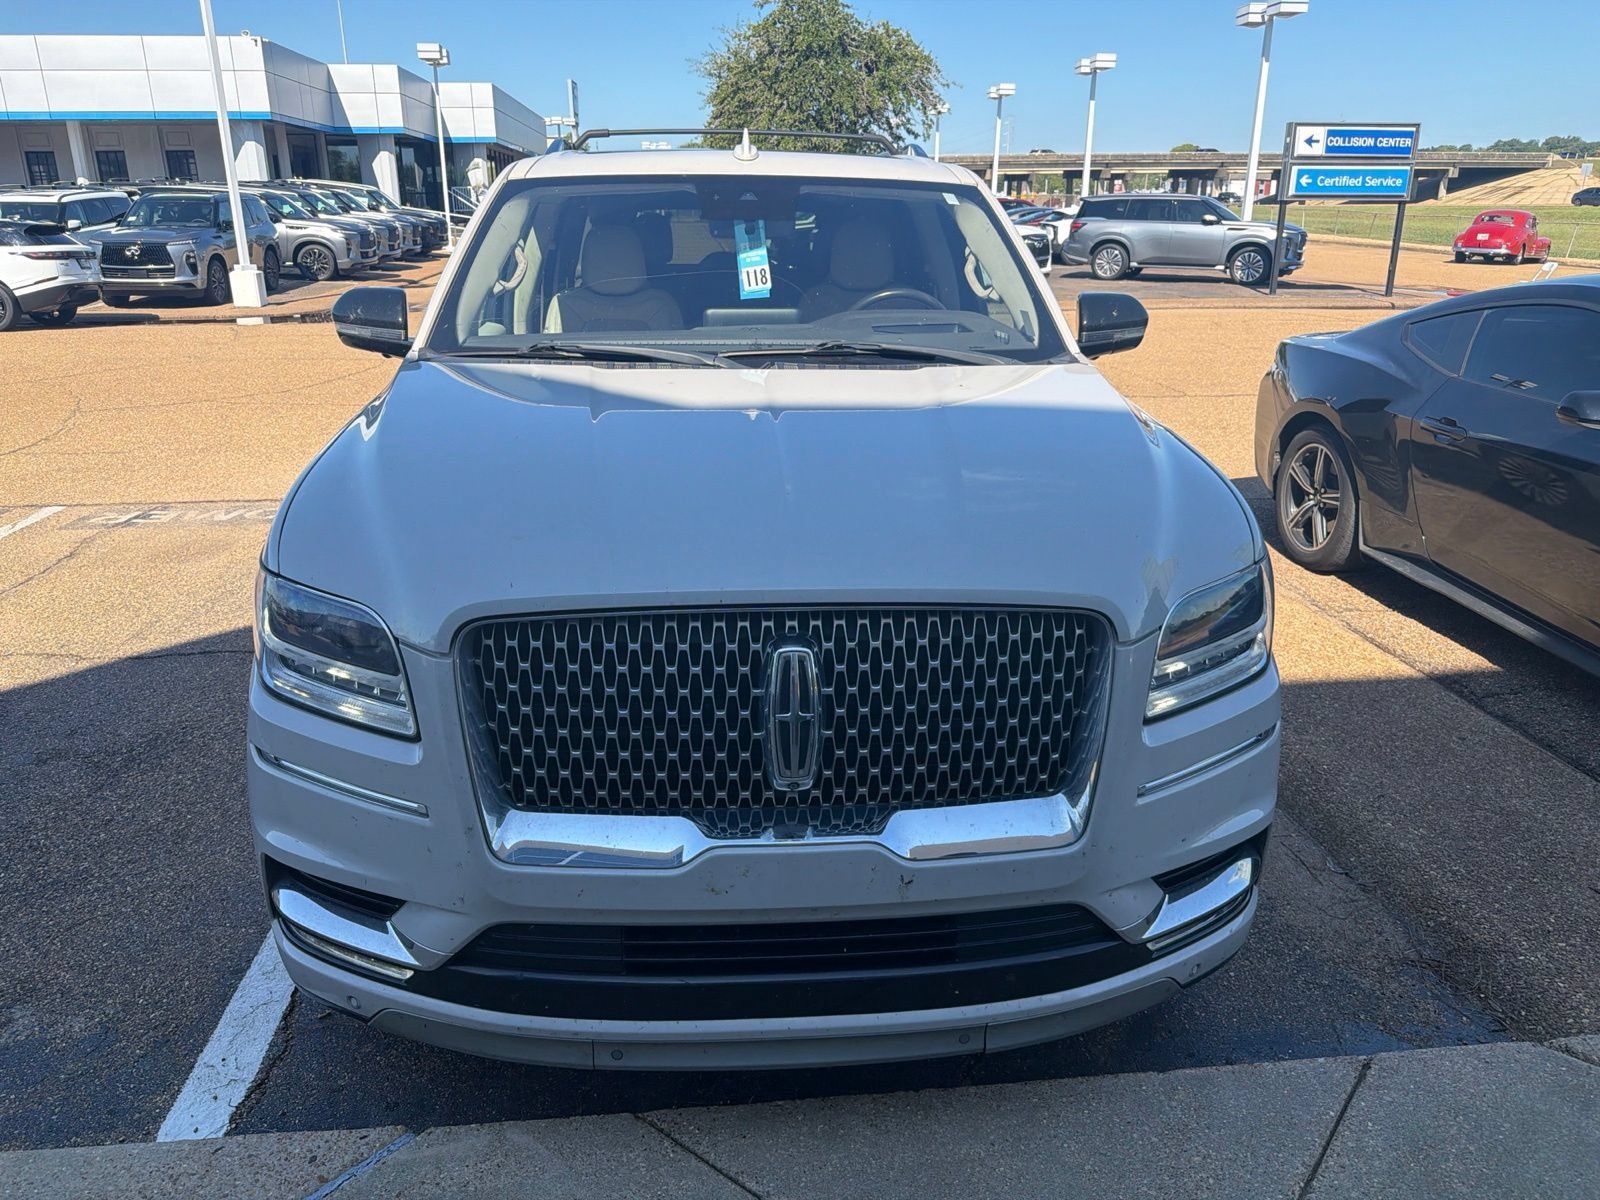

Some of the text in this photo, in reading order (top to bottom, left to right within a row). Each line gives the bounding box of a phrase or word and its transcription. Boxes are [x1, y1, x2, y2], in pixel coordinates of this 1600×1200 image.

[1327, 136, 1412, 148] COLLISION CENTER
[1317, 175, 1403, 187] Certified Service
[746, 268, 768, 287] 118
